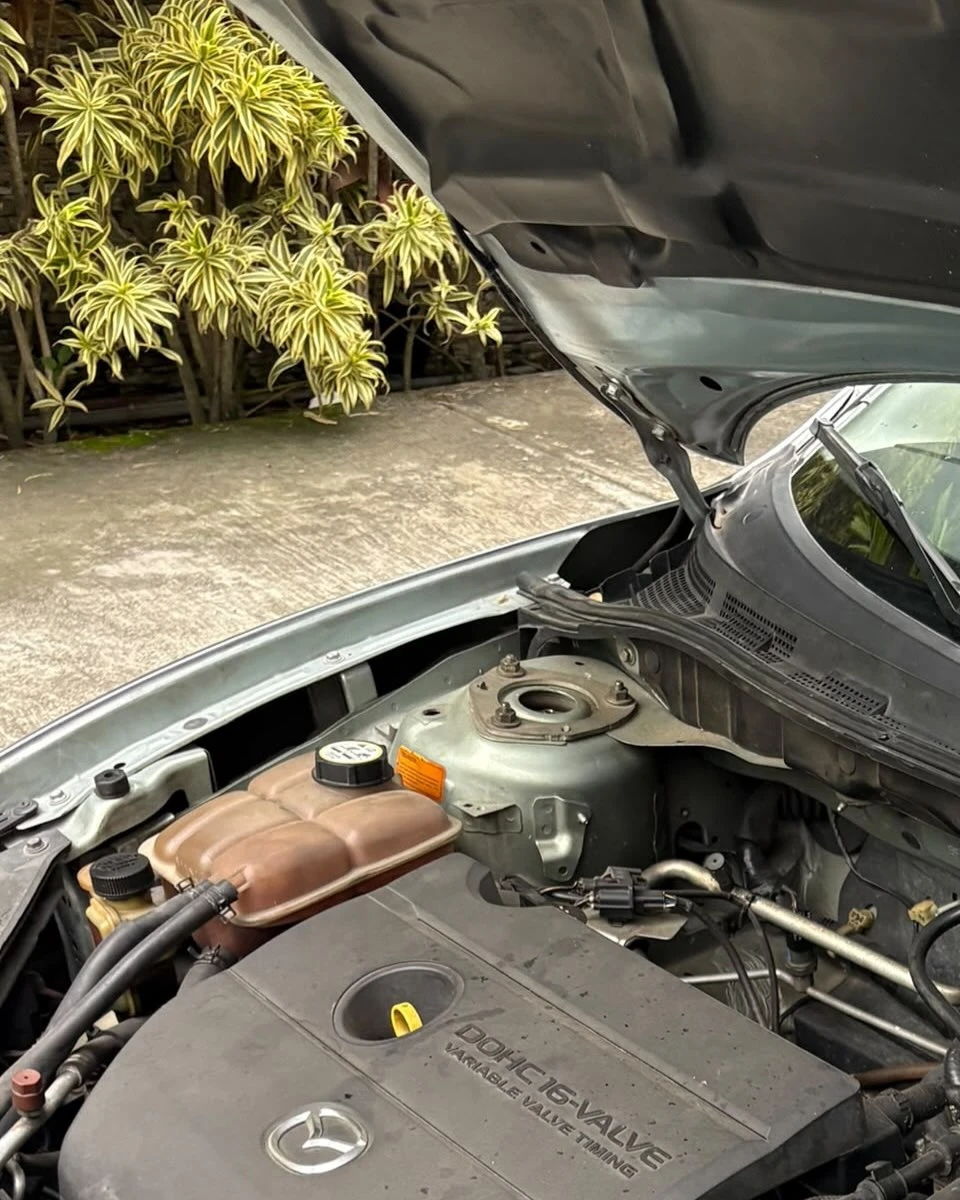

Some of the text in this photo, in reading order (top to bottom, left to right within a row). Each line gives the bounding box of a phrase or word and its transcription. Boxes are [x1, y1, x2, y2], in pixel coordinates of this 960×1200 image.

[445, 1042, 638, 1179] VARIABLE VALVE TIMING
[454, 1023, 672, 1170] DOHC 16-VALVE
